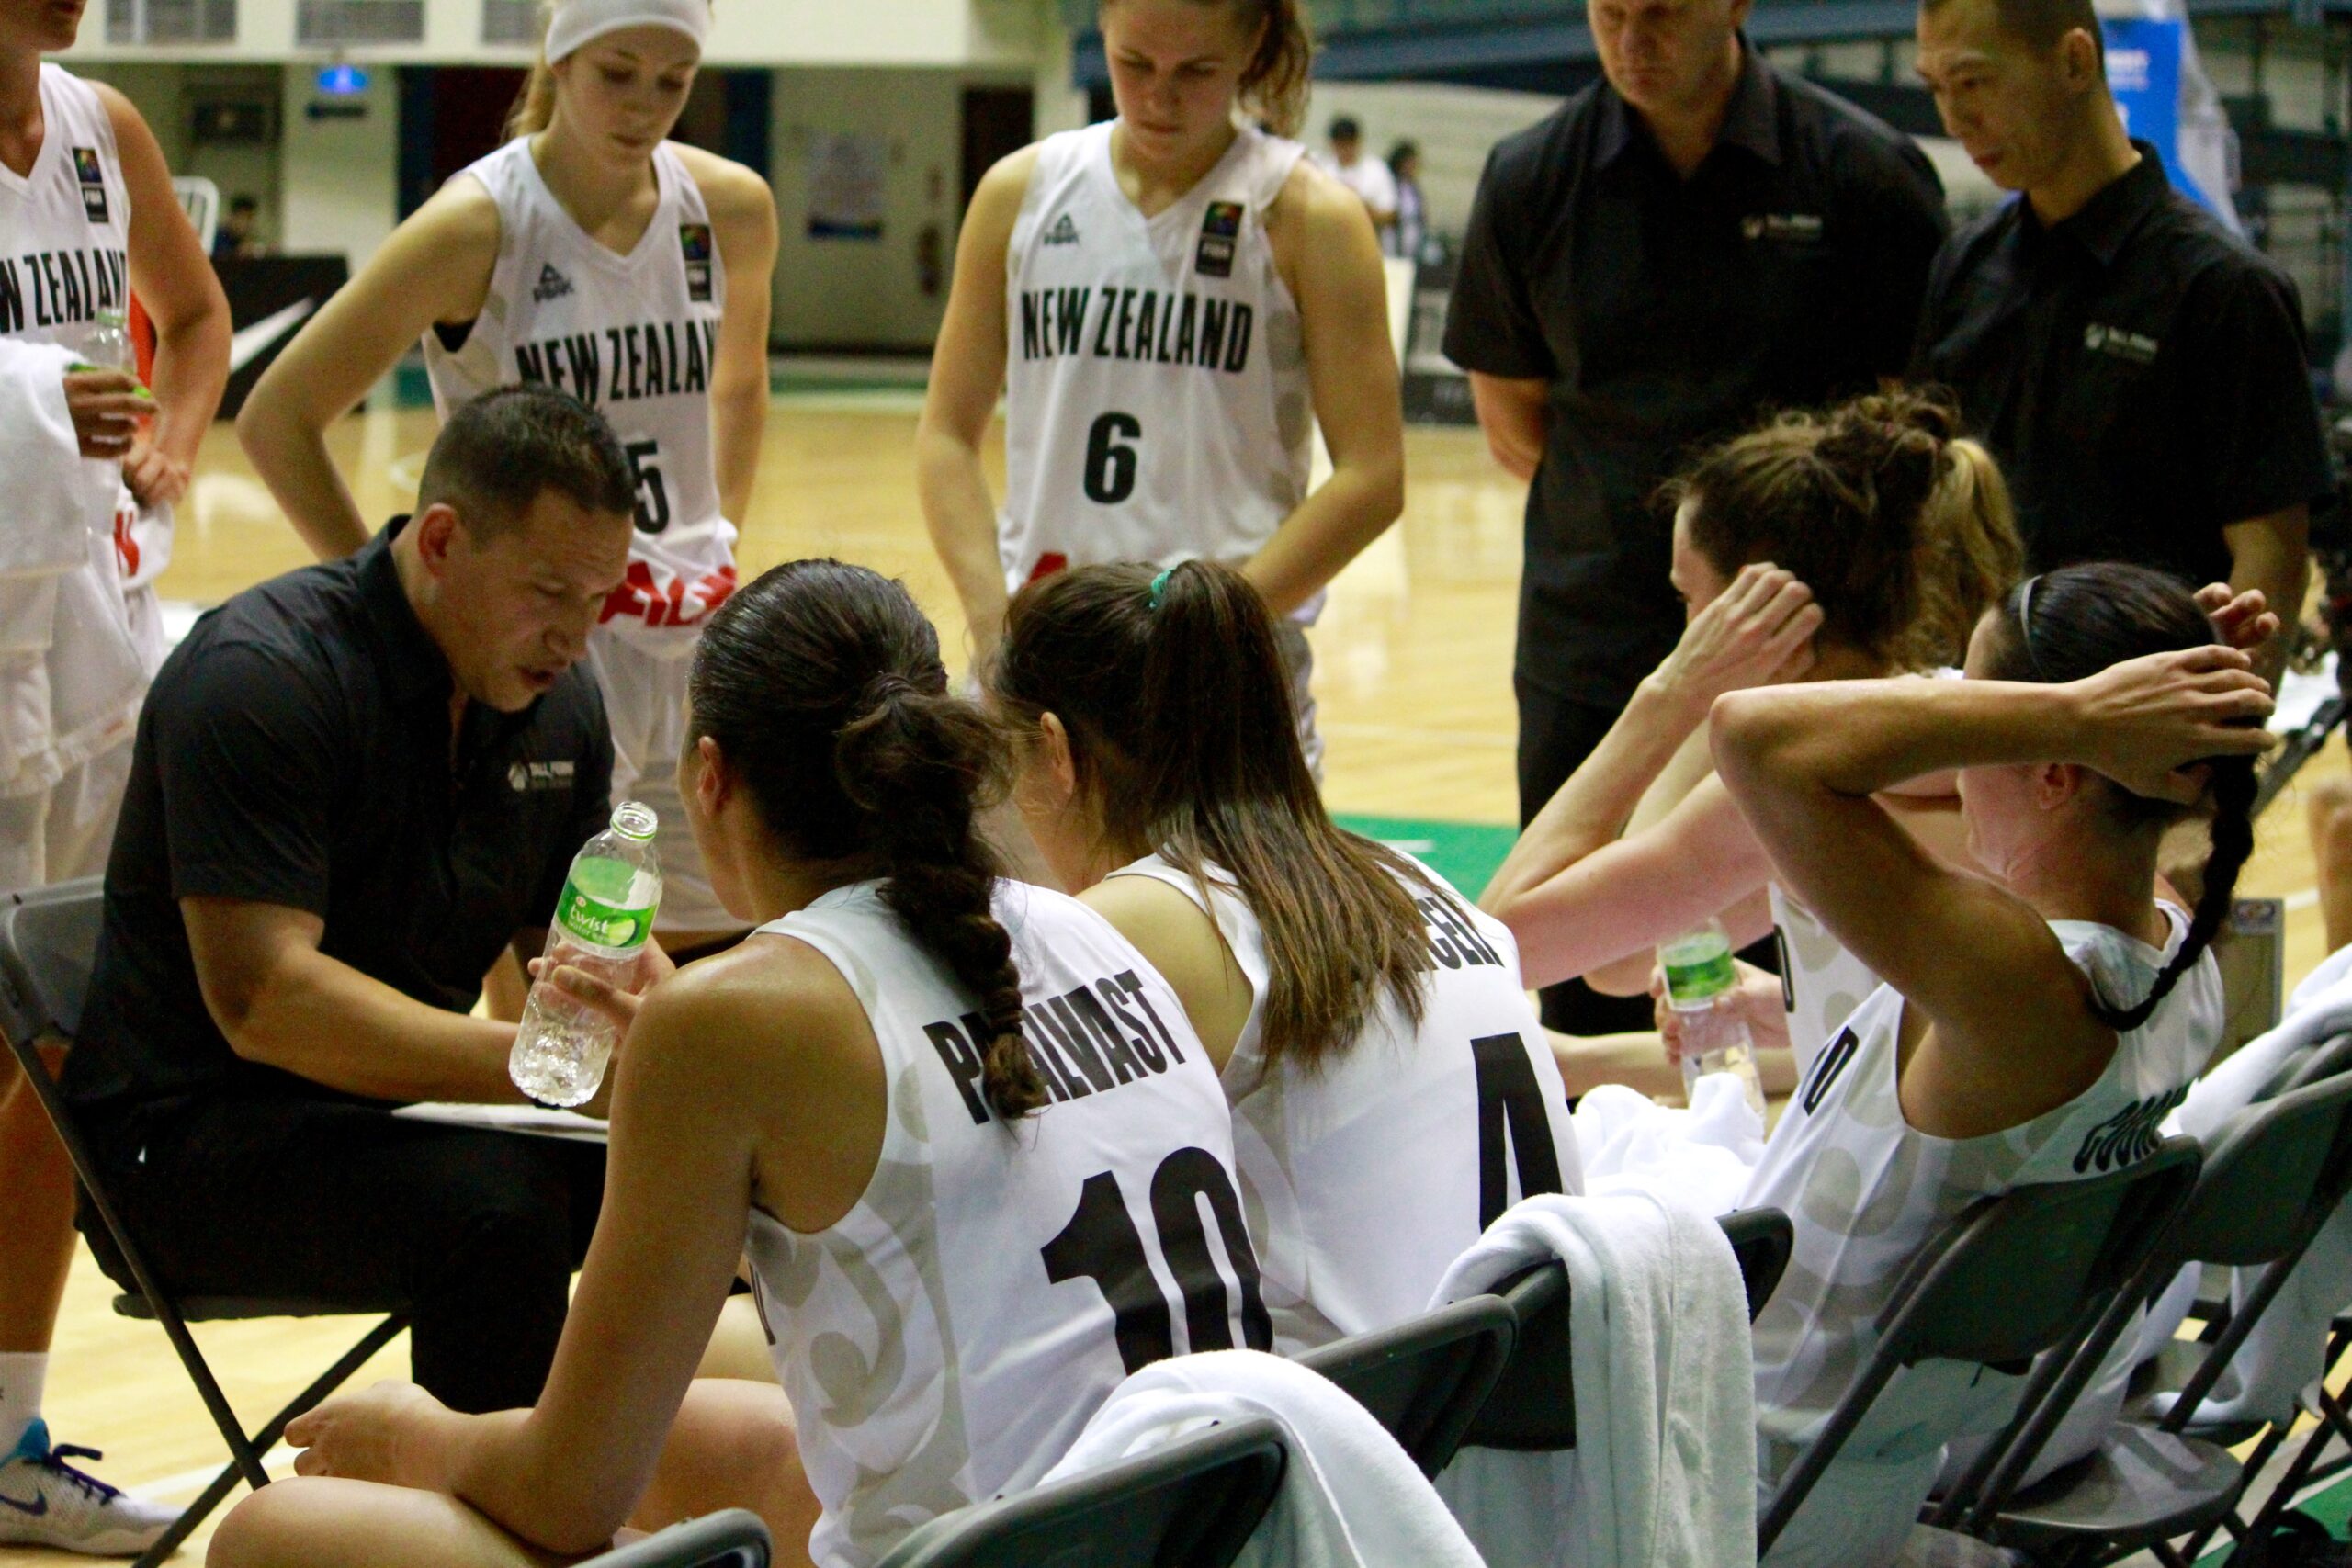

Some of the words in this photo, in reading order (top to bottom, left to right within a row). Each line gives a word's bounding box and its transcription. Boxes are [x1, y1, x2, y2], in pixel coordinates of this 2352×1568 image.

[515, 333, 600, 405] NEW
[1022, 287, 1091, 360] NEW
[1094, 288, 1253, 373] ZEALAND
[626, 439, 669, 534] 5
[1084, 412, 1141, 504] 6
[570, 904, 610, 934] twist
[922, 969, 1186, 1125] PALVAST
[1040, 1146, 1273, 1377] 10
